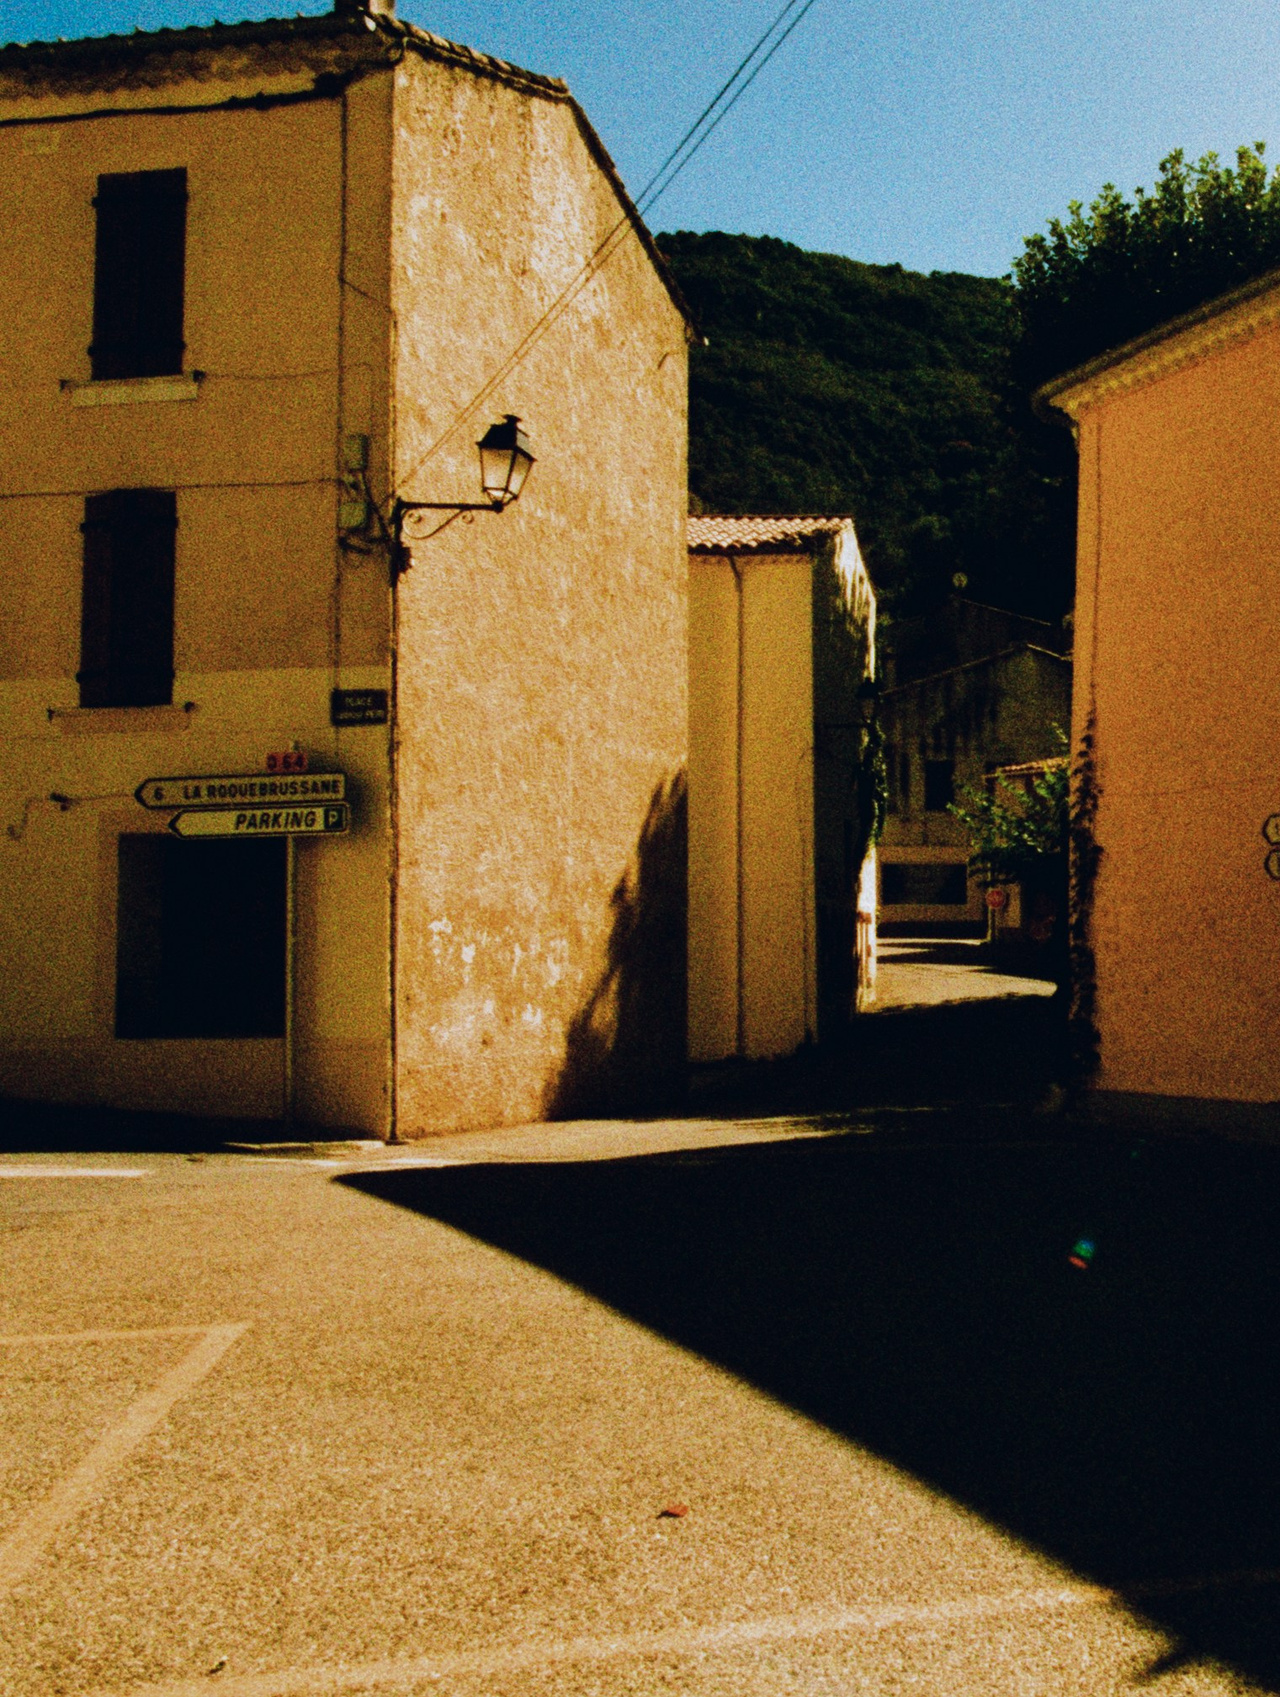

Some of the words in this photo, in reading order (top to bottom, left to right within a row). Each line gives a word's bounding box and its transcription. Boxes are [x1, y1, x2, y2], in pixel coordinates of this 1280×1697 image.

[344, 696, 374, 707] PLACE
[282, 753, 306, 769] 64
[153, 786, 164, 801] 6
[183, 785, 202, 800] LA
[206, 779, 341, 799] ROQUEBRUSSANE
[234, 810, 317, 830] PARKING
[328, 810, 339, 826] P
